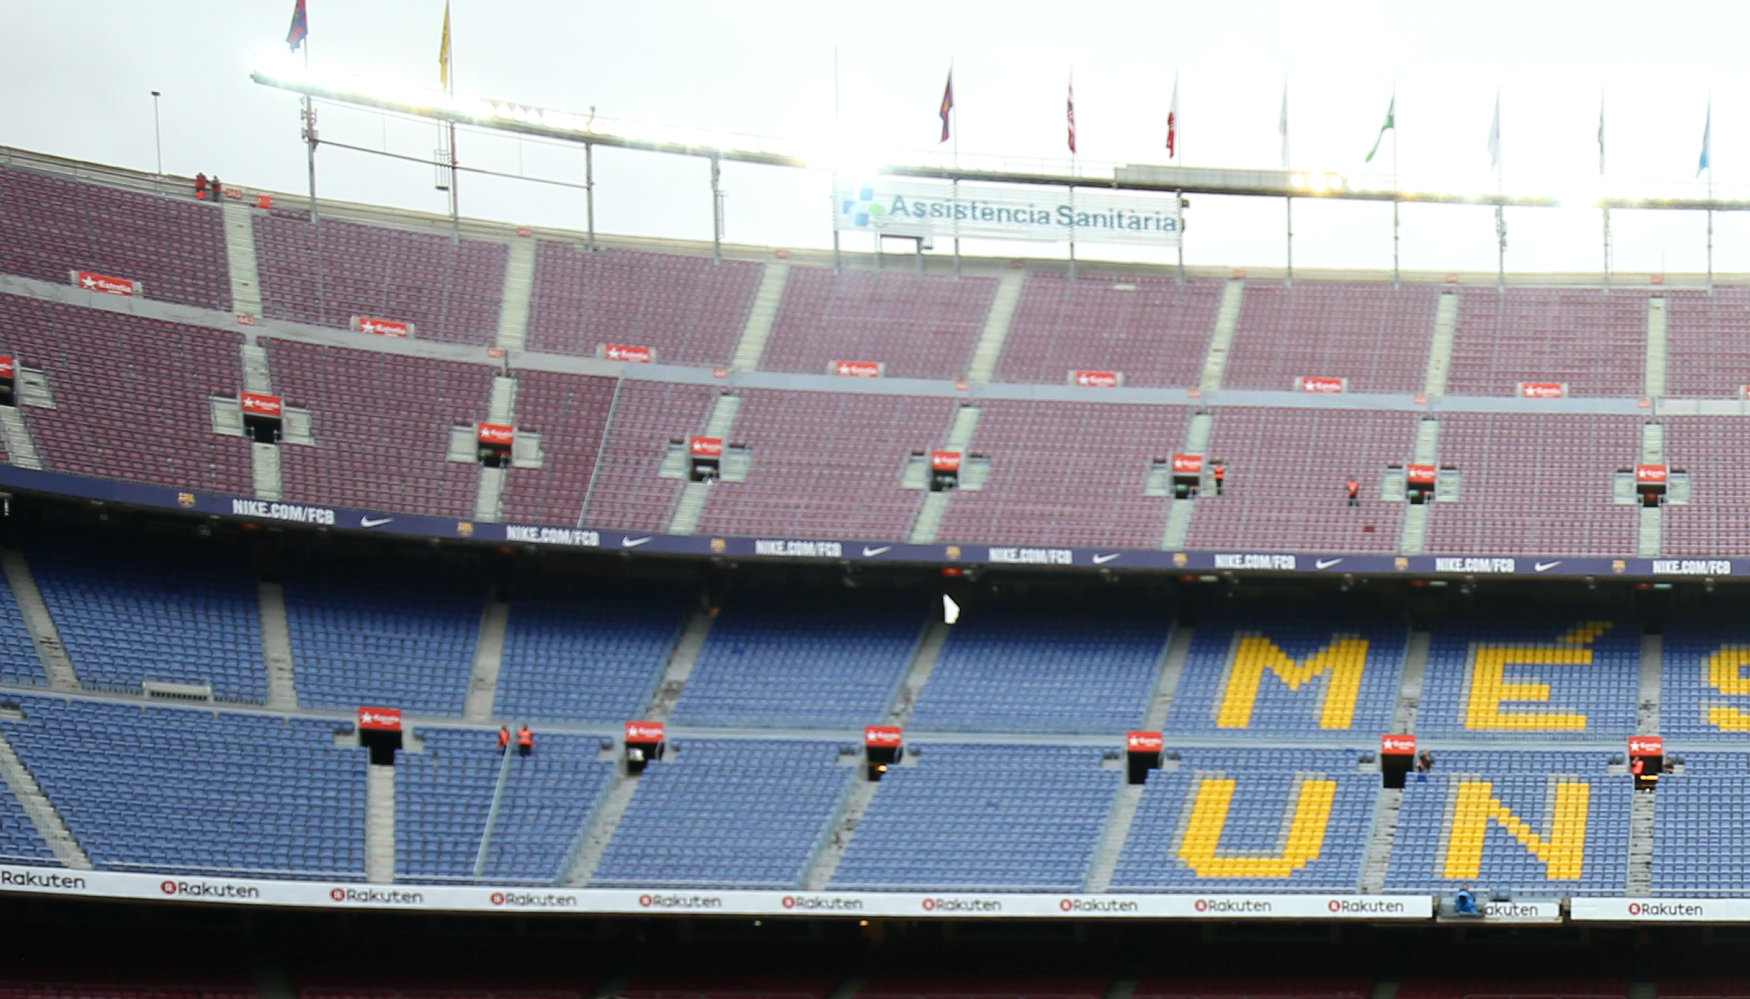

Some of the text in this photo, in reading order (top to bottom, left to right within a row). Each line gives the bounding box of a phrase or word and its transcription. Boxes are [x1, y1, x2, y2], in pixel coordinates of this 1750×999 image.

[1056, 205, 1177, 233] Sanitària
[232, 499, 335, 525] NIKE.COM/FCB
[506, 525, 600, 547] NIKE.COM/FCB
[1435, 557, 1515, 573] NIKE.COM/FCB
[1652, 560, 1731, 575] NIKE.COM/FCB
[1178, 779, 1590, 879] UN
[1, 870, 86, 890] Rakuten
[178, 881, 260, 900] Rakuten
[346, 887, 424, 904] Rakuten
[505, 892, 577, 907] Rakuten
[652, 894, 723, 909] Rakuten
[795, 896, 863, 911] Rakuten
[936, 897, 1002, 912] Rakuten
[1073, 898, 1139, 912] Rakuten
[1208, 898, 1272, 913] Rakuten
[1341, 899, 1405, 914] Rakuten
[1484, 901, 1539, 917] akuten
[1641, 902, 1704, 917] Rakuten
